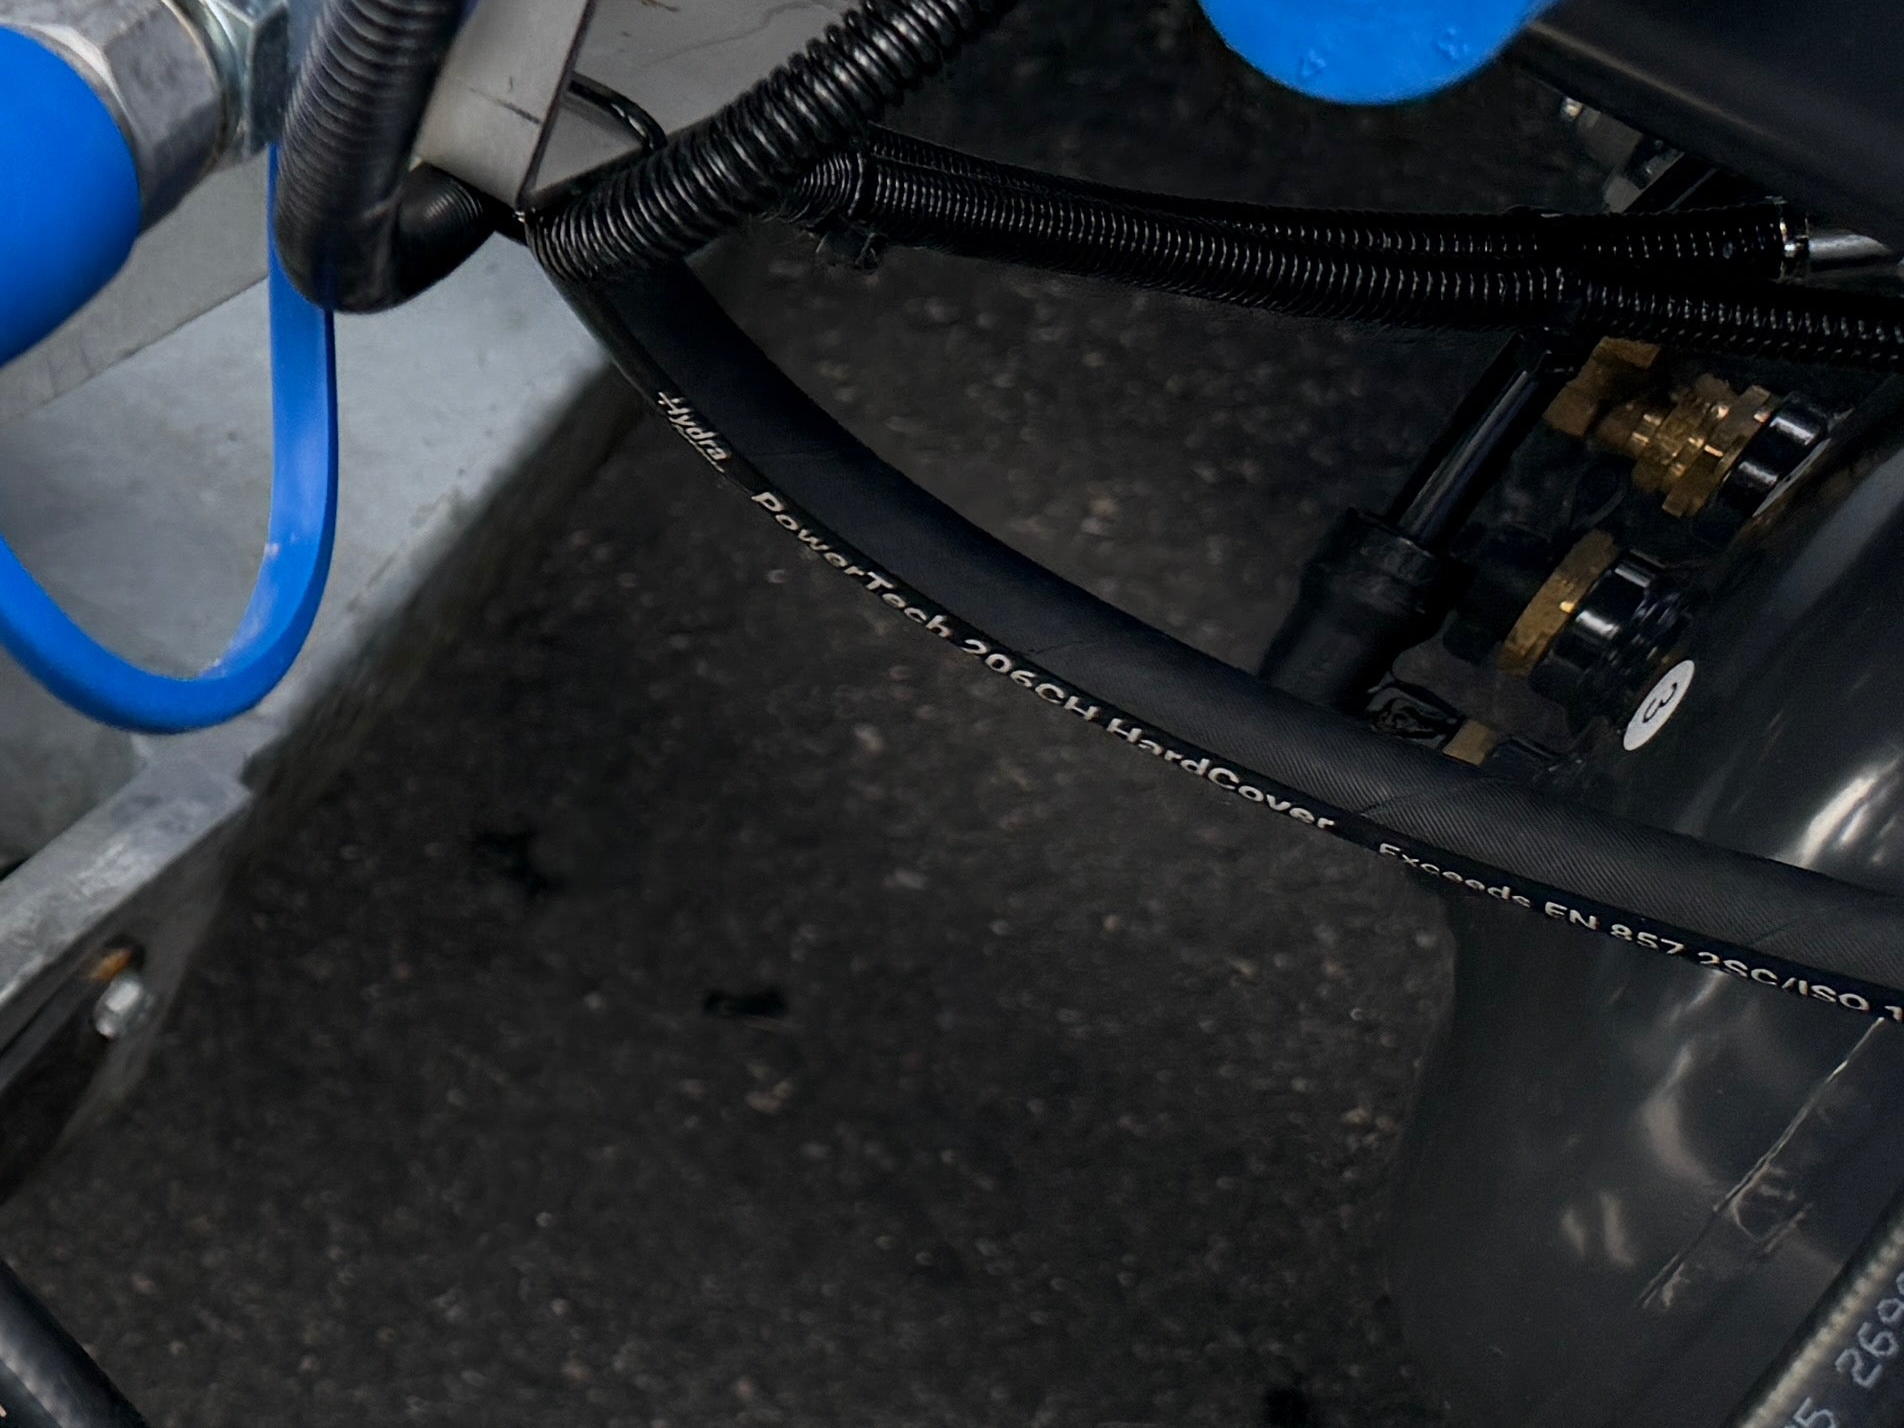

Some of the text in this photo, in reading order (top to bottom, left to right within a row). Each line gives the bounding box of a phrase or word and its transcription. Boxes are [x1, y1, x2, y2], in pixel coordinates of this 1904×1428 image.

[658, 391, 730, 462] Hydra
[751, 491, 953, 638] PowerTech
[961, 638, 1099, 722] 206CH
[1106, 717, 1336, 830] HardCover
[1379, 842, 1531, 909] Exceeds
[1544, 901, 1599, 931] EN
[1610, 923, 1686, 956] 857
[1698, 951, 1871, 1012] 2SC/ISO
